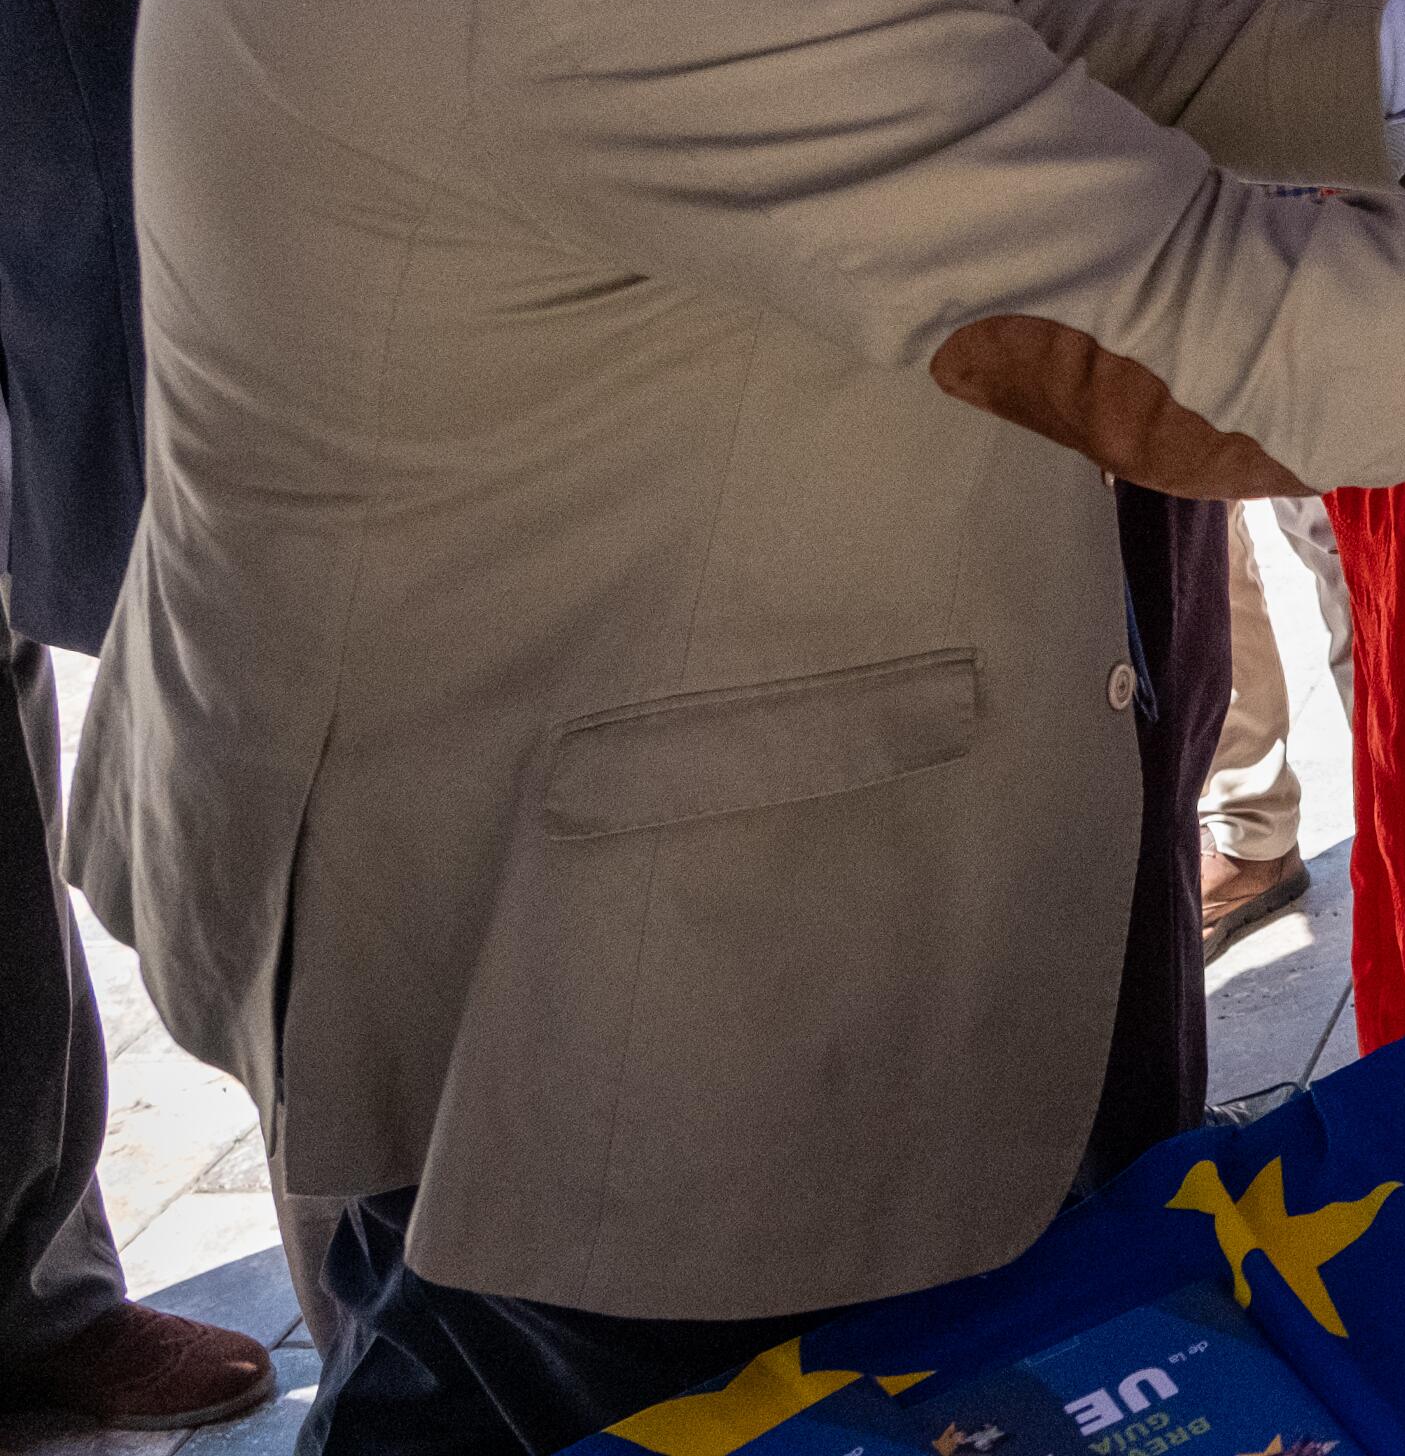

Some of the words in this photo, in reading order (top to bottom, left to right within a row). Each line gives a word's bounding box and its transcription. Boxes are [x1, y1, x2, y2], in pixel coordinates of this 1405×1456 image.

[1167, 1350, 1186, 1364] la
[1188, 1340, 1209, 1357] de
[1063, 1366, 1179, 1436] UE
